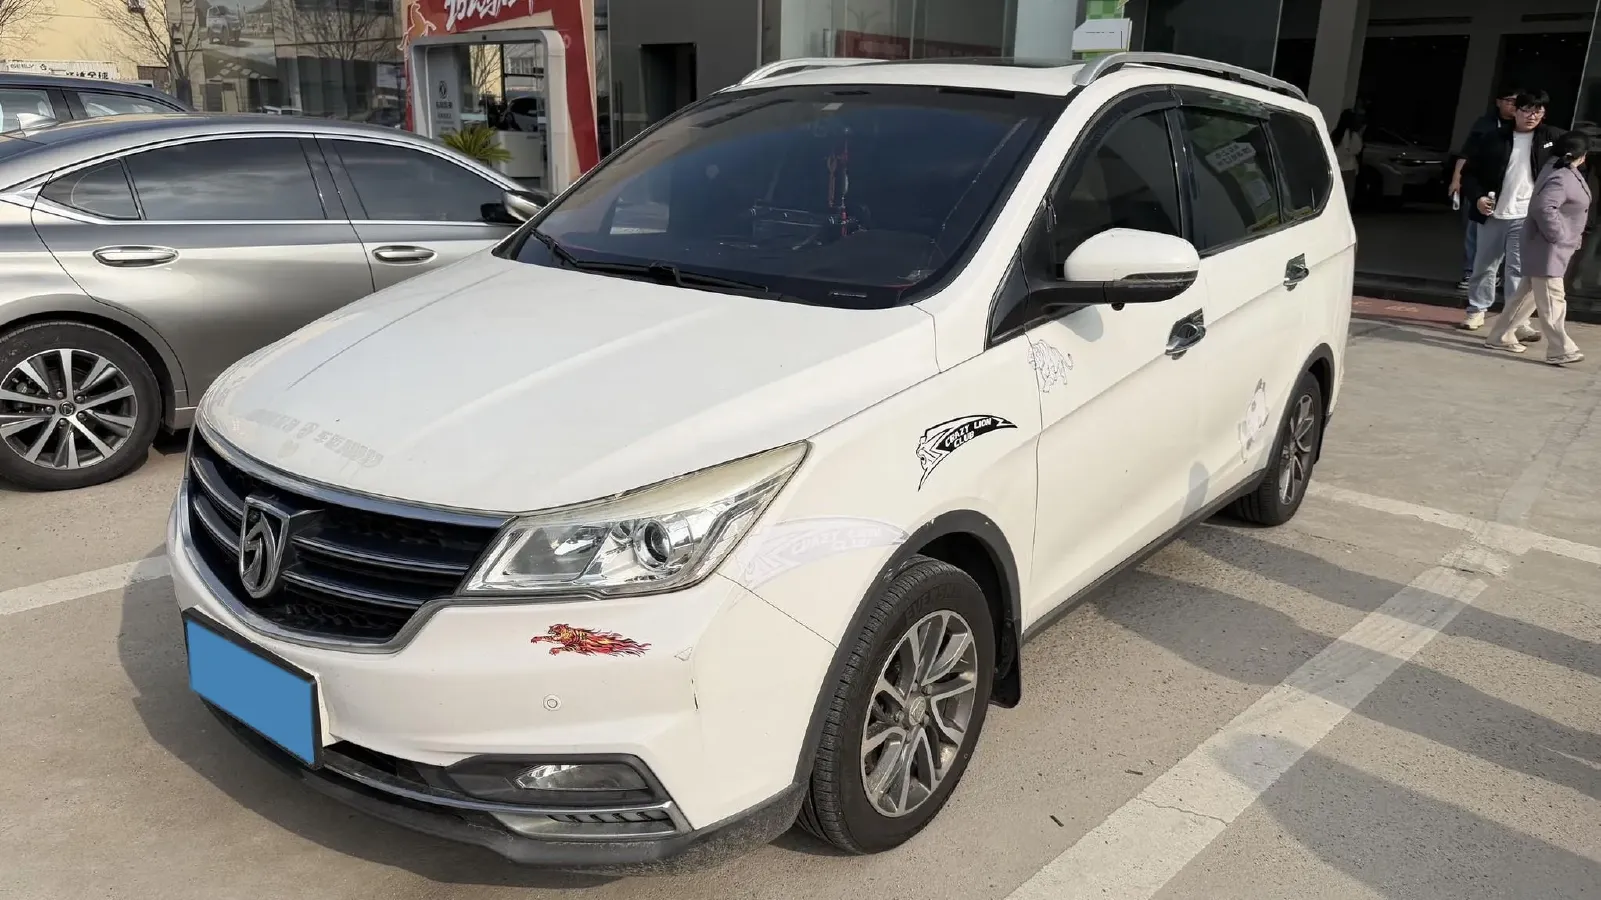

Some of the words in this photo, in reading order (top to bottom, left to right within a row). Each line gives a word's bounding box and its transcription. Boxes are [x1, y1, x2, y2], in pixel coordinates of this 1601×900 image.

[944, 424, 970, 448] CRAZY
[973, 417, 992, 429] LION
[953, 430, 975, 448] CLUB
